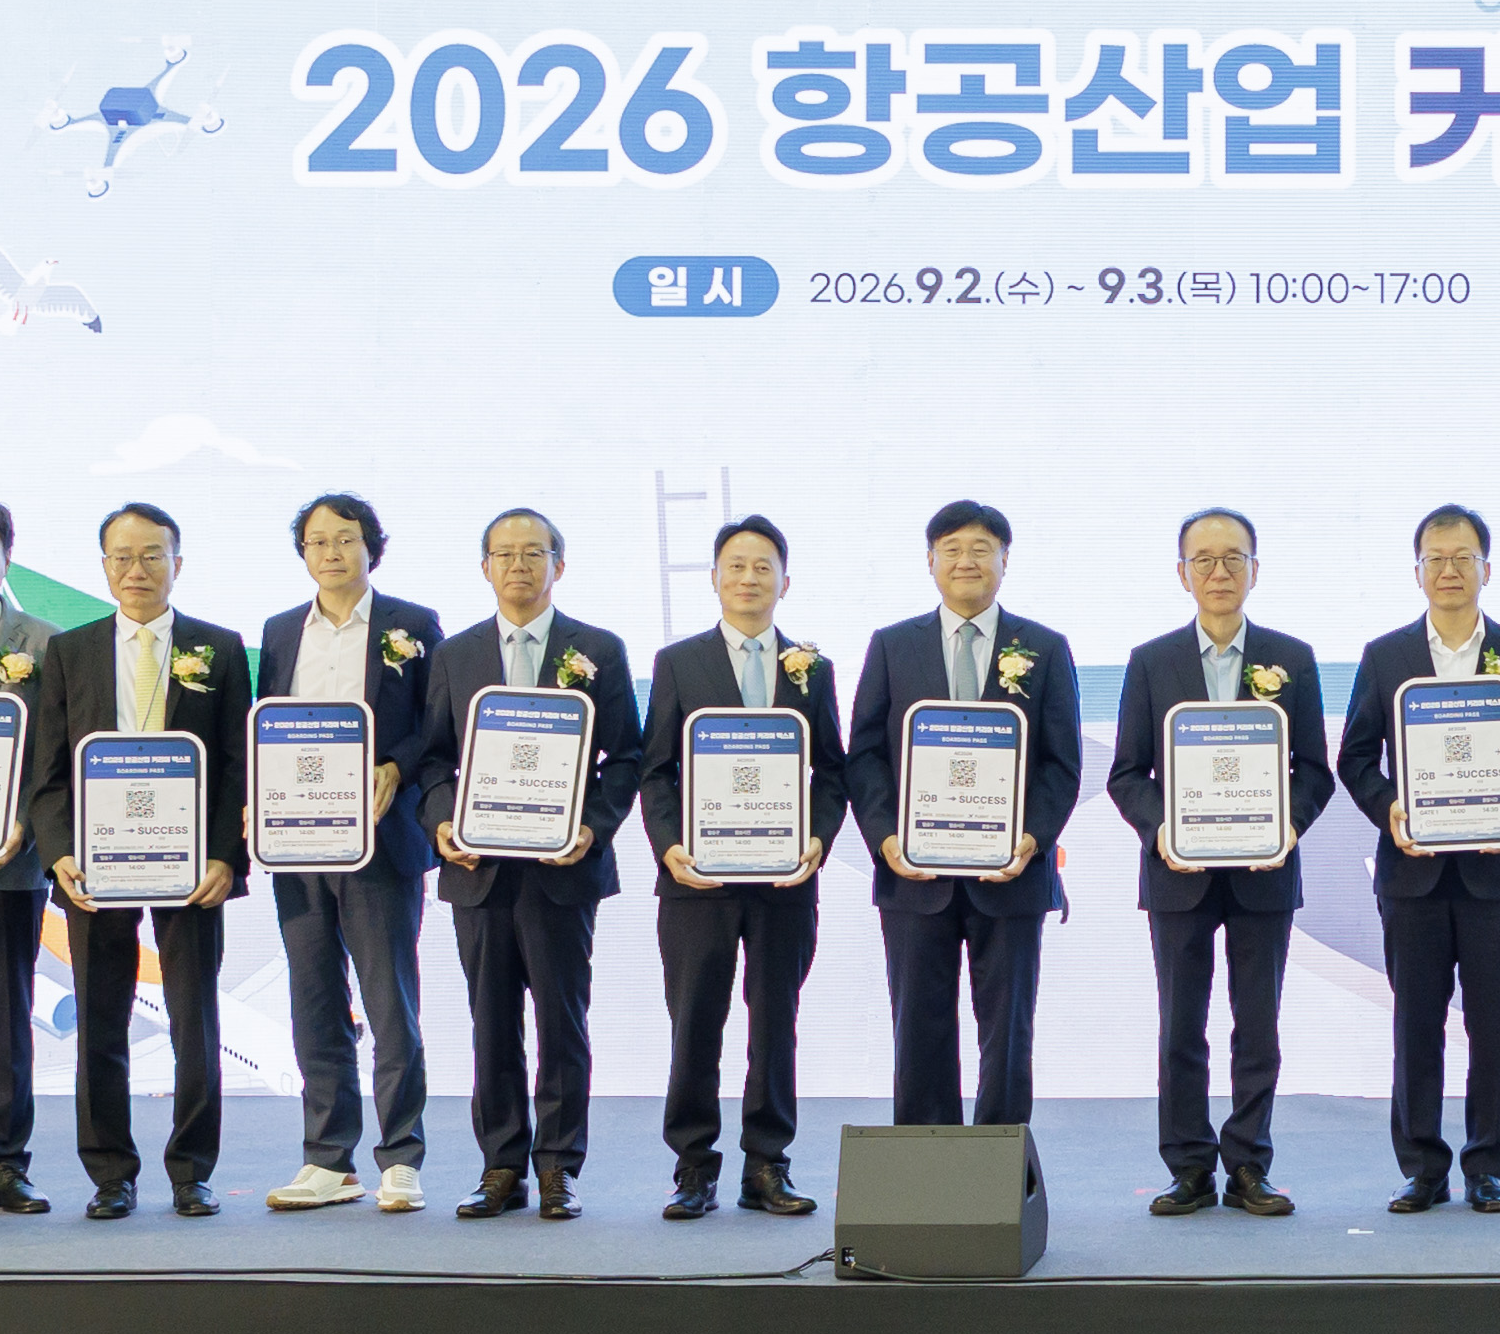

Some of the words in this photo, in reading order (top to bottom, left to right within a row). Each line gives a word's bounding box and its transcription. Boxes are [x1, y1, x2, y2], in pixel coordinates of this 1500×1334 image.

[302, 41, 714, 177] 2026
[765, 39, 1343, 176] 항공산업
[1249, 271, 1471, 306] 10:00~17:00
[1414, 772, 1435, 780] JOB
[476, 776, 498, 784] JOB
[518, 778, 568, 789] SUCCESS
[265, 792, 286, 800] JOB
[308, 791, 356, 800] SUCCESS
[1182, 790, 1202, 798] JOB
[1224, 789, 1272, 797] SUCCESS
[917, 793, 937, 802] JOB
[959, 795, 1007, 805] SUCCESS
[701, 802, 721, 810] JOB
[743, 802, 792, 810] SUCCESS
[93, 827, 115, 835] JOB
[137, 826, 188, 834] SUCCESS
